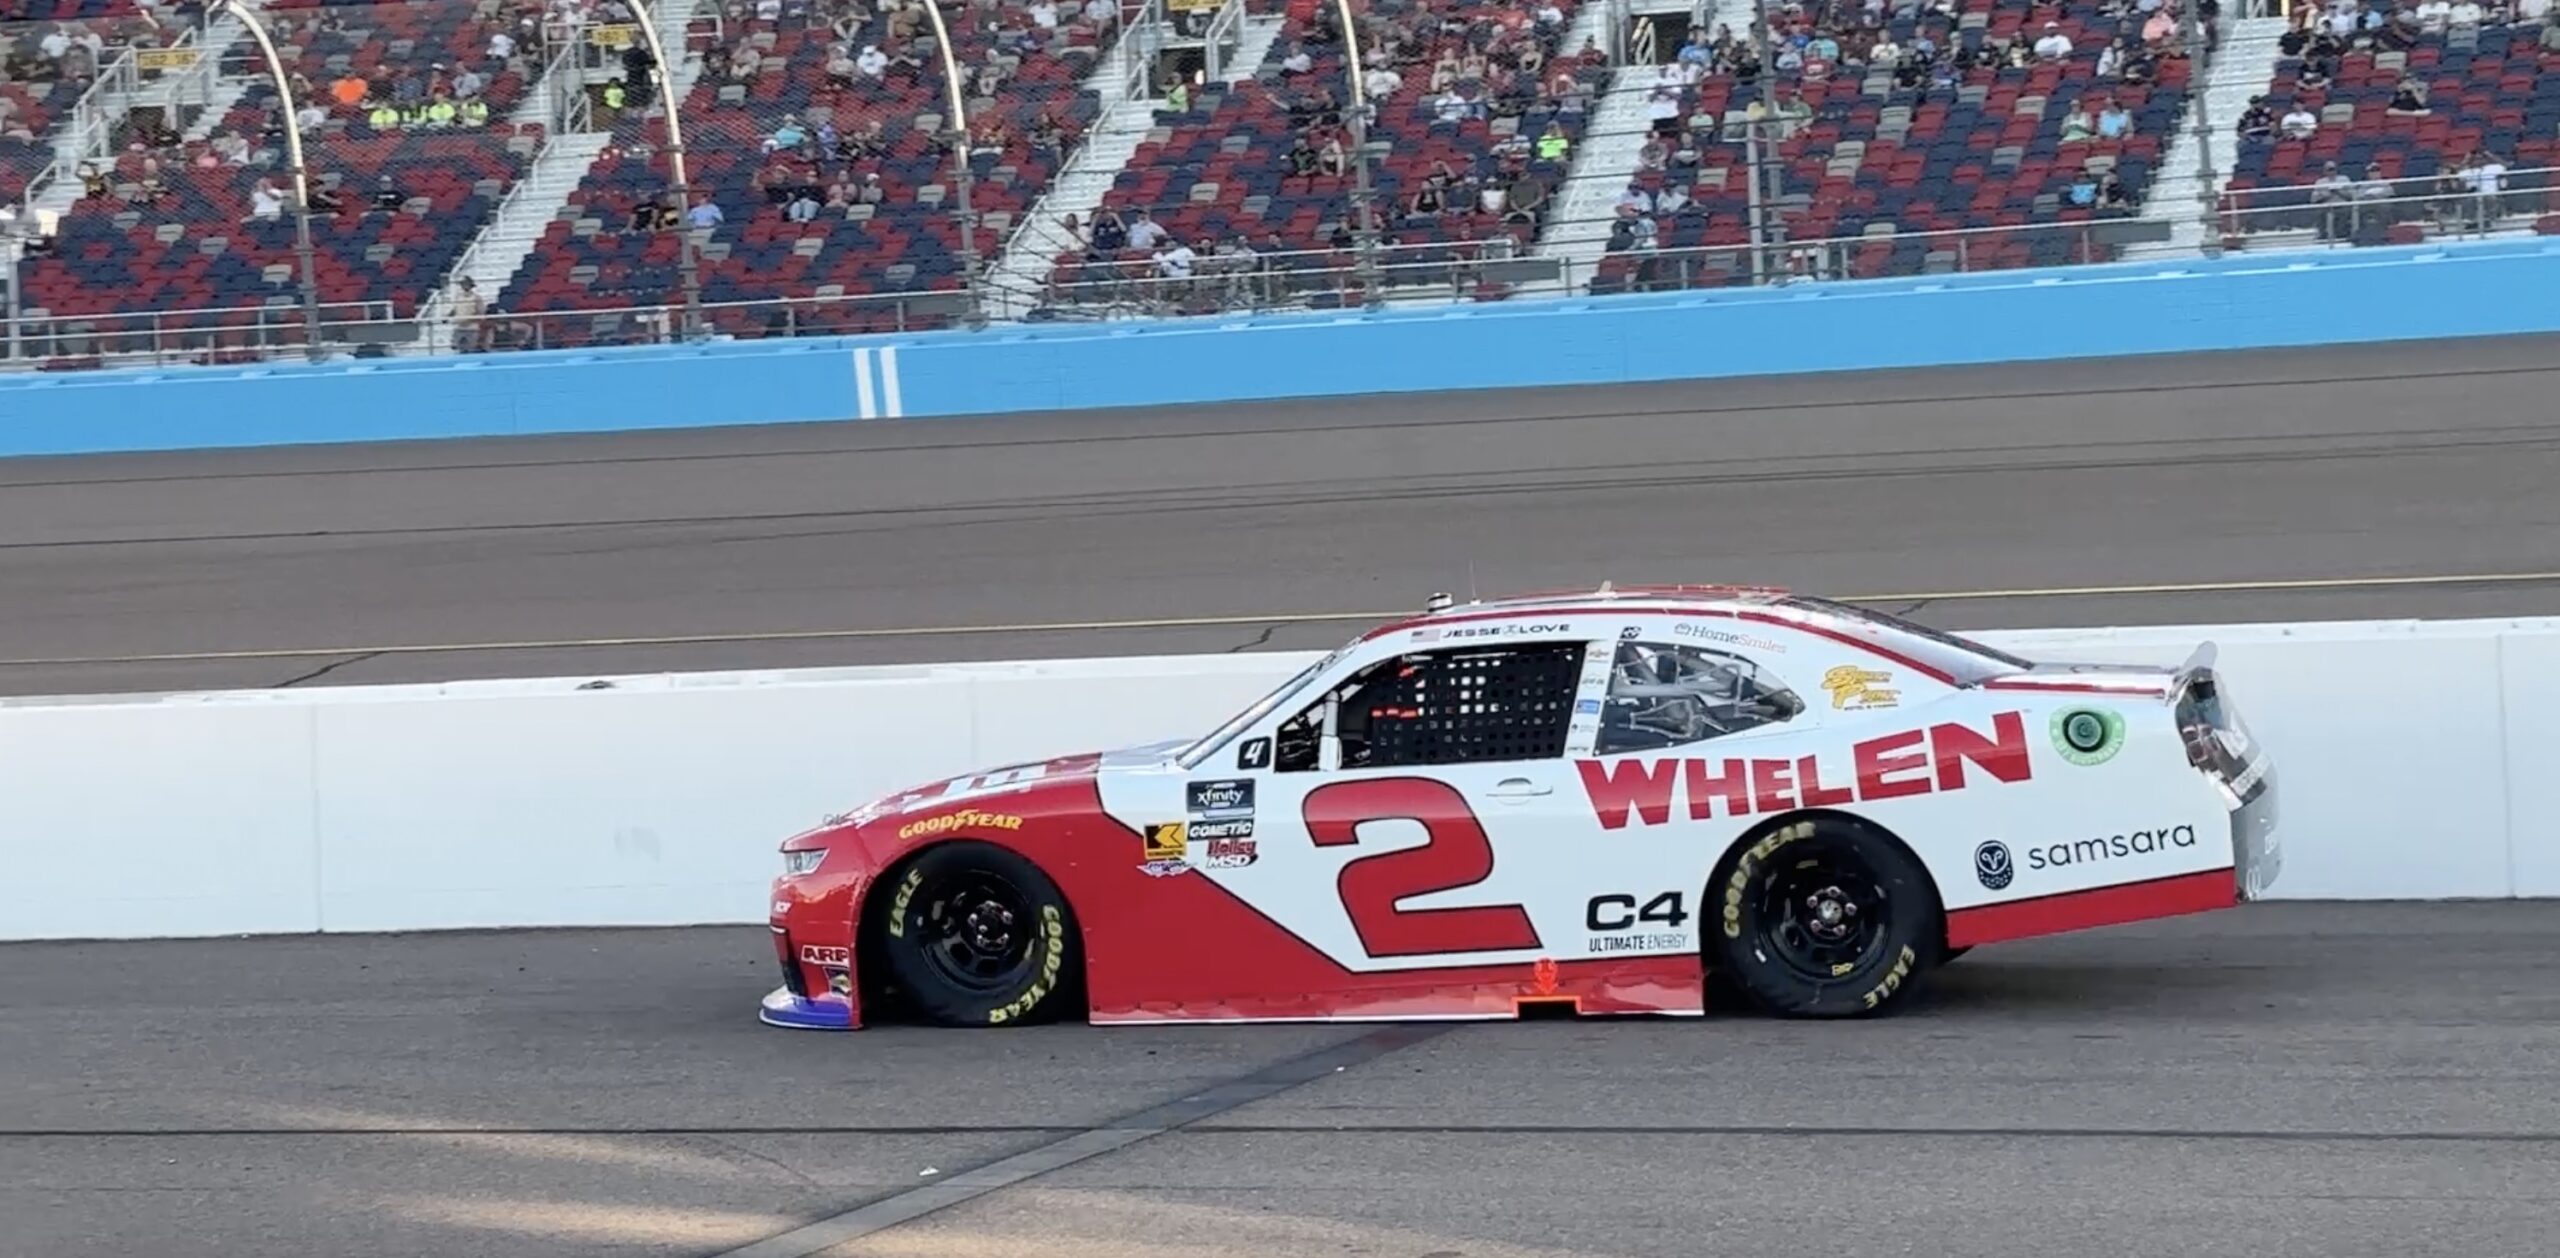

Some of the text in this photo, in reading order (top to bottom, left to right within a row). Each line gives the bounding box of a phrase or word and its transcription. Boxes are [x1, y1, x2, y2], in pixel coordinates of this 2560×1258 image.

[1442, 624, 1571, 639] JESSE LOVE
[1692, 626, 1787, 653] HomeSmiles
[1244, 742, 1265, 765] 4
[1574, 710, 2032, 830] WHELEN
[1197, 789, 1244, 806] xfinity
[899, 809, 1023, 839] GOODYEAR
[1206, 854, 1251, 868] MSD
[2028, 823, 2196, 870] samsara
[1301, 775, 1543, 958] 2
[1723, 821, 1816, 938] GOODYEAR
[890, 868, 923, 938] EAGLE
[1586, 891, 1689, 931] C4
[803, 947, 848, 962] ARP
[1589, 934, 1688, 952] ULTIMATE ENERGY
[989, 904, 1063, 1023] GOODYEAR
[1862, 943, 1916, 1009] EAGLE
